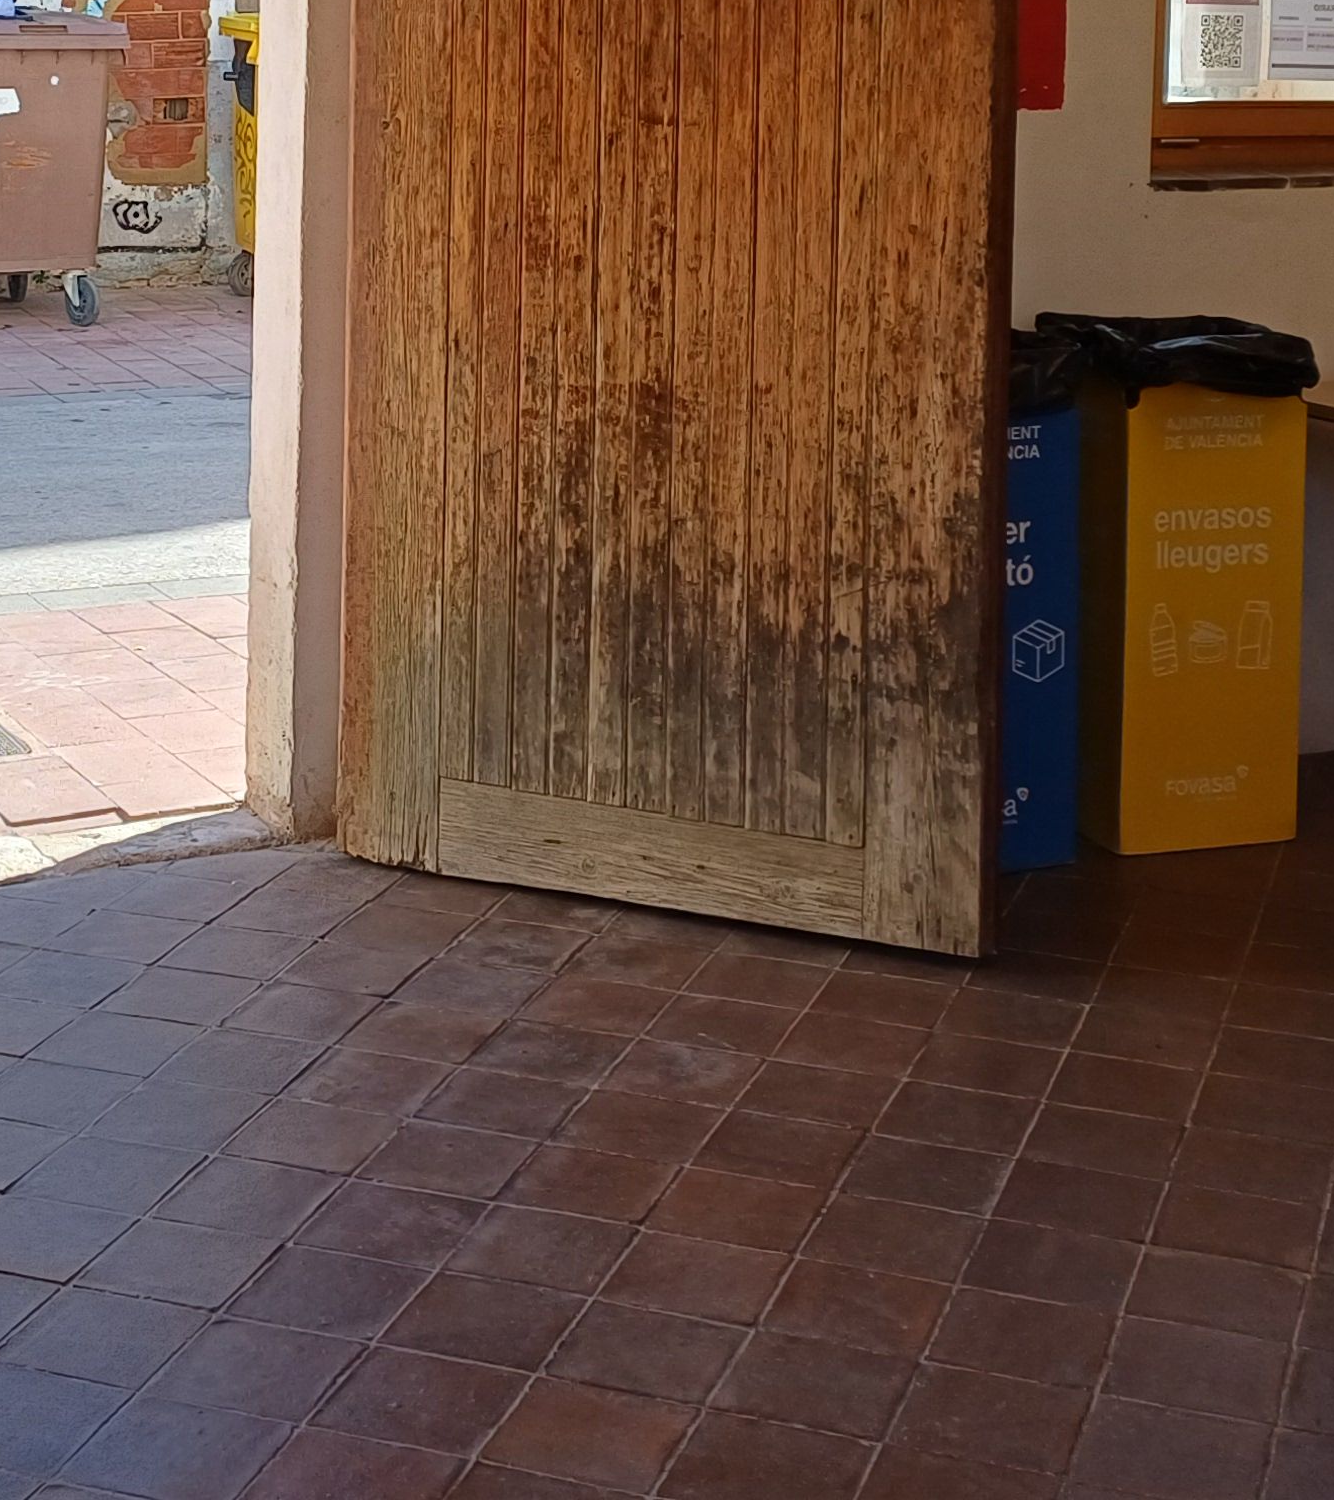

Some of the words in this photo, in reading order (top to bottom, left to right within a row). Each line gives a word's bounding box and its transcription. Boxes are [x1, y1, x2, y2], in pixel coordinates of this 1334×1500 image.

[1007, 425, 1042, 440] ENT
[1164, 435, 1184, 451] DE
[1154, 506, 1272, 533] envasos
[1155, 539, 1270, 573] lleugers
